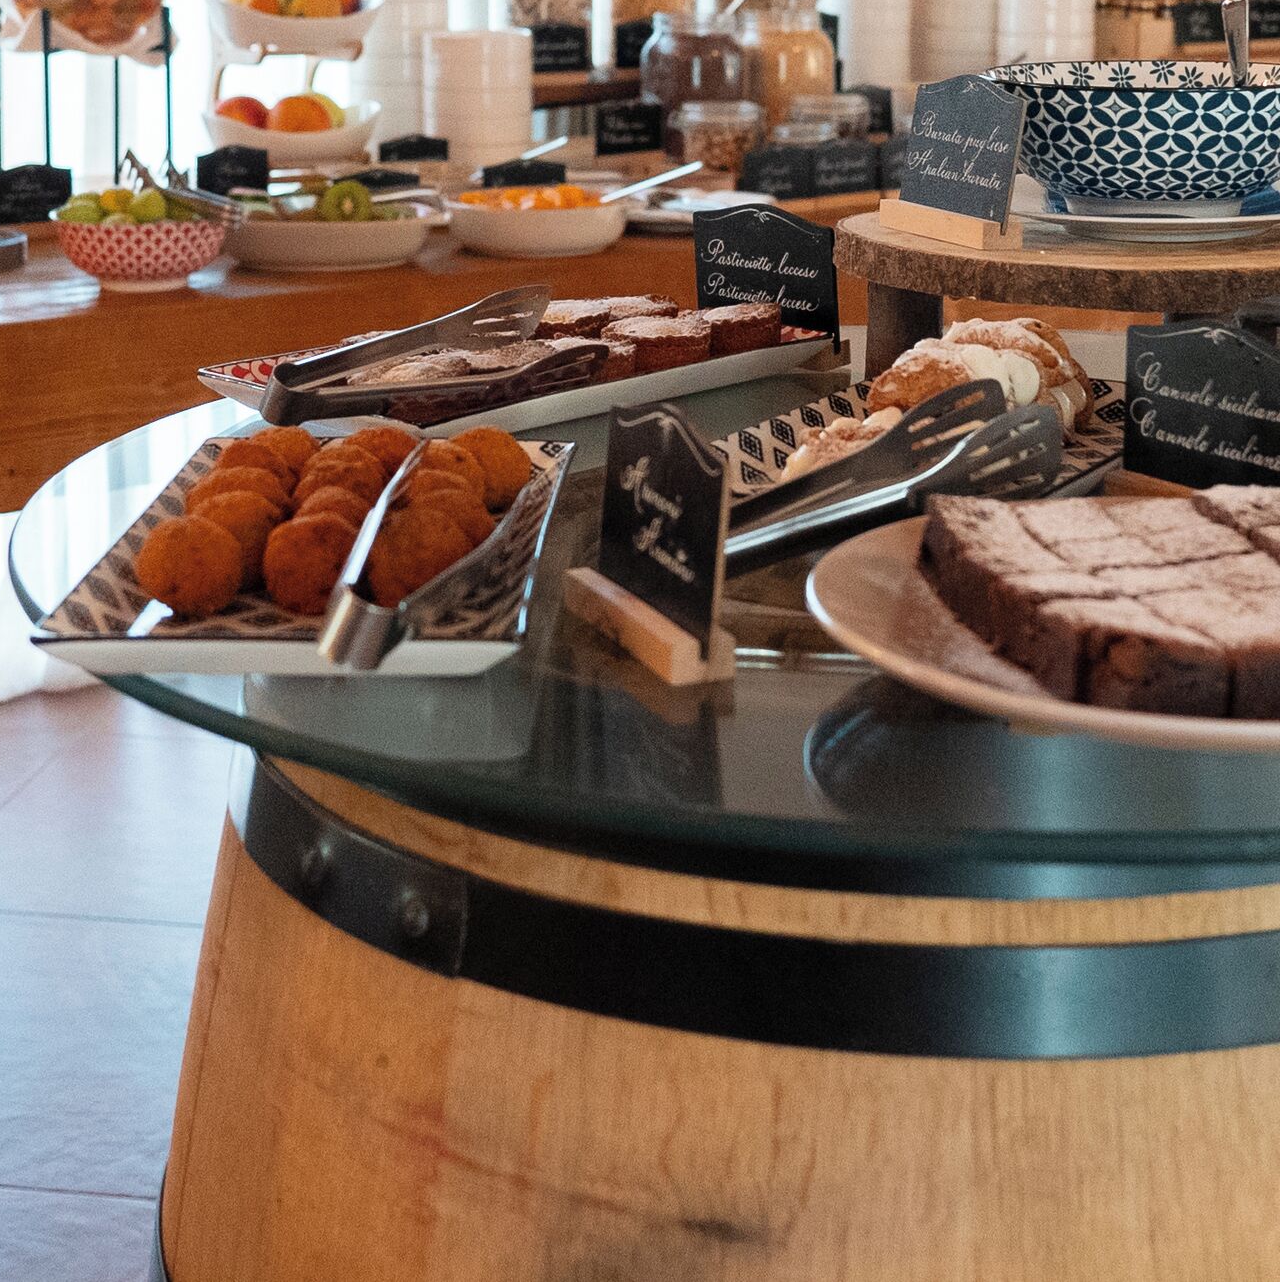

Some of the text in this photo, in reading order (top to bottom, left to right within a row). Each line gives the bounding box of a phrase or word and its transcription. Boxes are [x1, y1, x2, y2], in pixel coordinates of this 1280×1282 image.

[701, 238, 819, 278] Pasticciotto leccese
[776, 284, 820, 312] leccese
[1135, 351, 1215, 407] Cannolo
[1129, 396, 1210, 453] Cannolo
